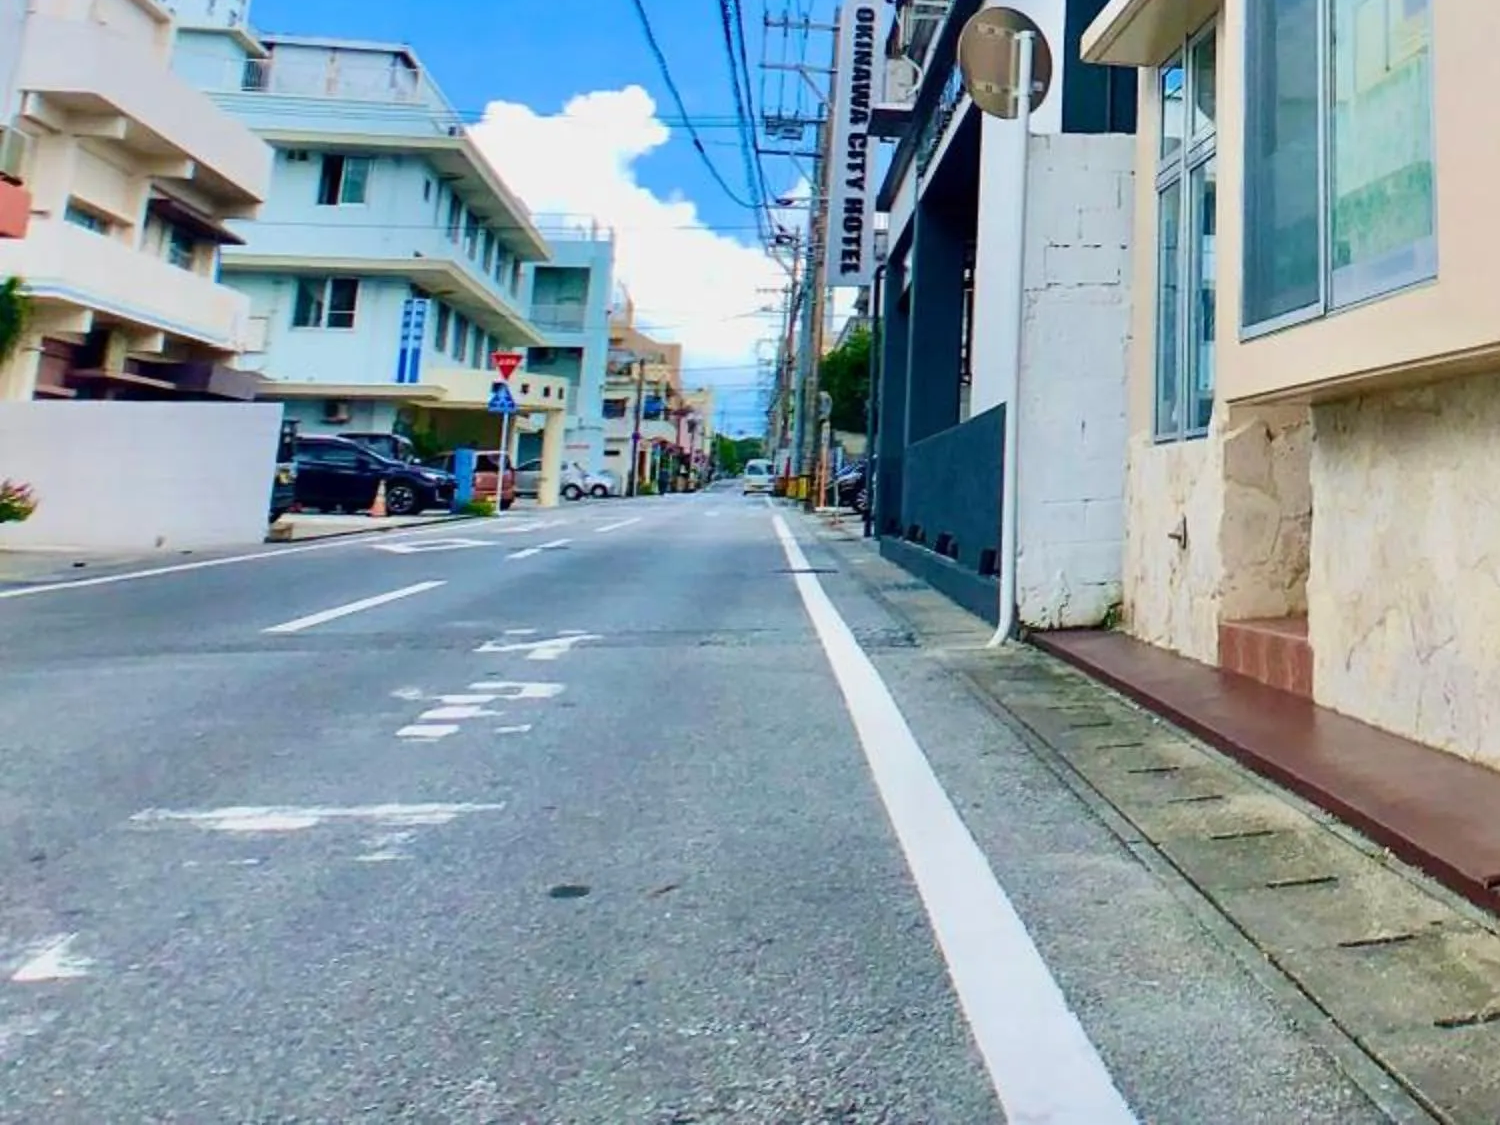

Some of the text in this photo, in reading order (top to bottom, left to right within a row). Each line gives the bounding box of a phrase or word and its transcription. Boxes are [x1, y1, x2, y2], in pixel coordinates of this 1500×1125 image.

[840, 7, 875, 276] OKINAWA CITY HOTEL
